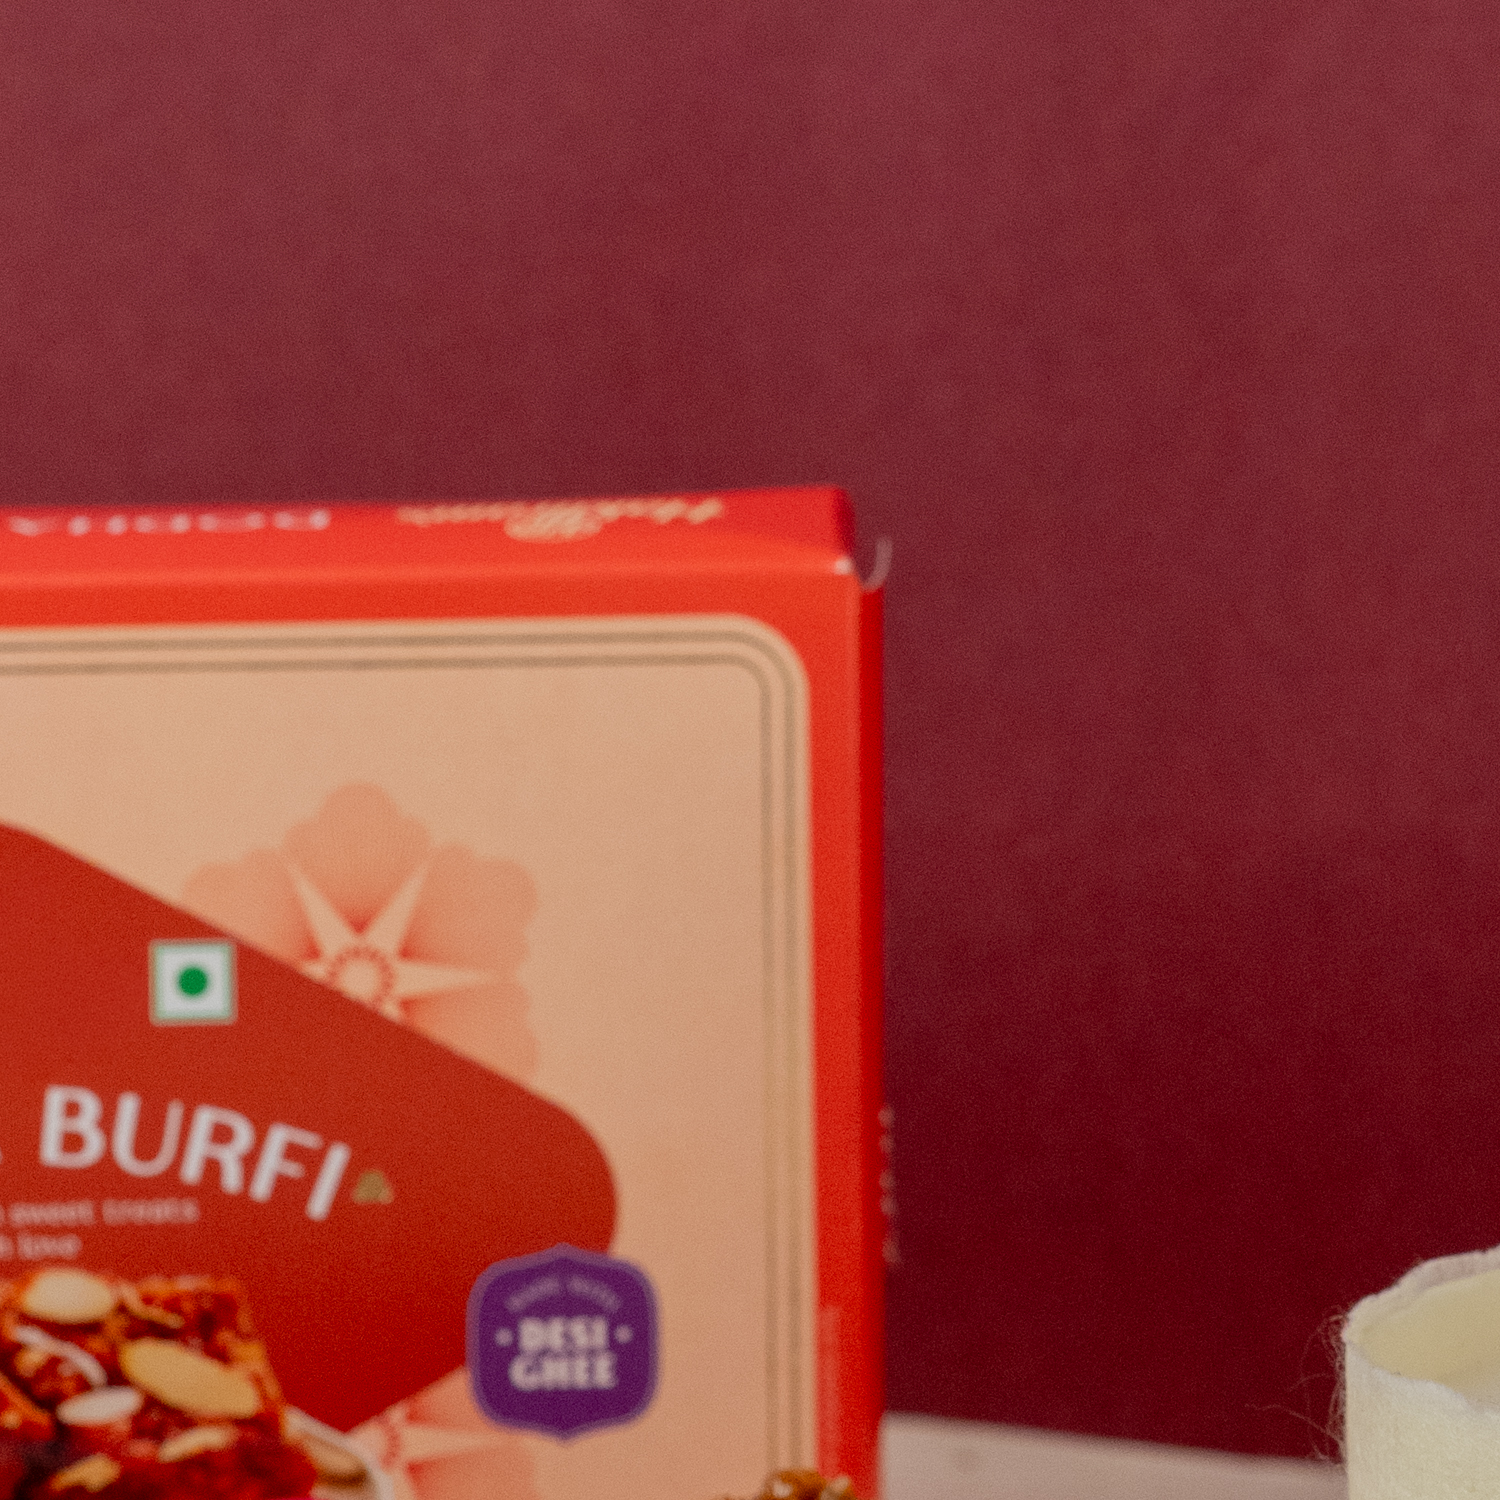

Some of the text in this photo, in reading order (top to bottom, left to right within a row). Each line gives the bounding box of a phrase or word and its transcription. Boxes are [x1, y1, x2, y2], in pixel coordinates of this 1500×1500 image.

[39, 1083, 352, 1222] BURFI
[518, 1315, 609, 1352] DESI
[508, 1352, 618, 1392] GHEE
